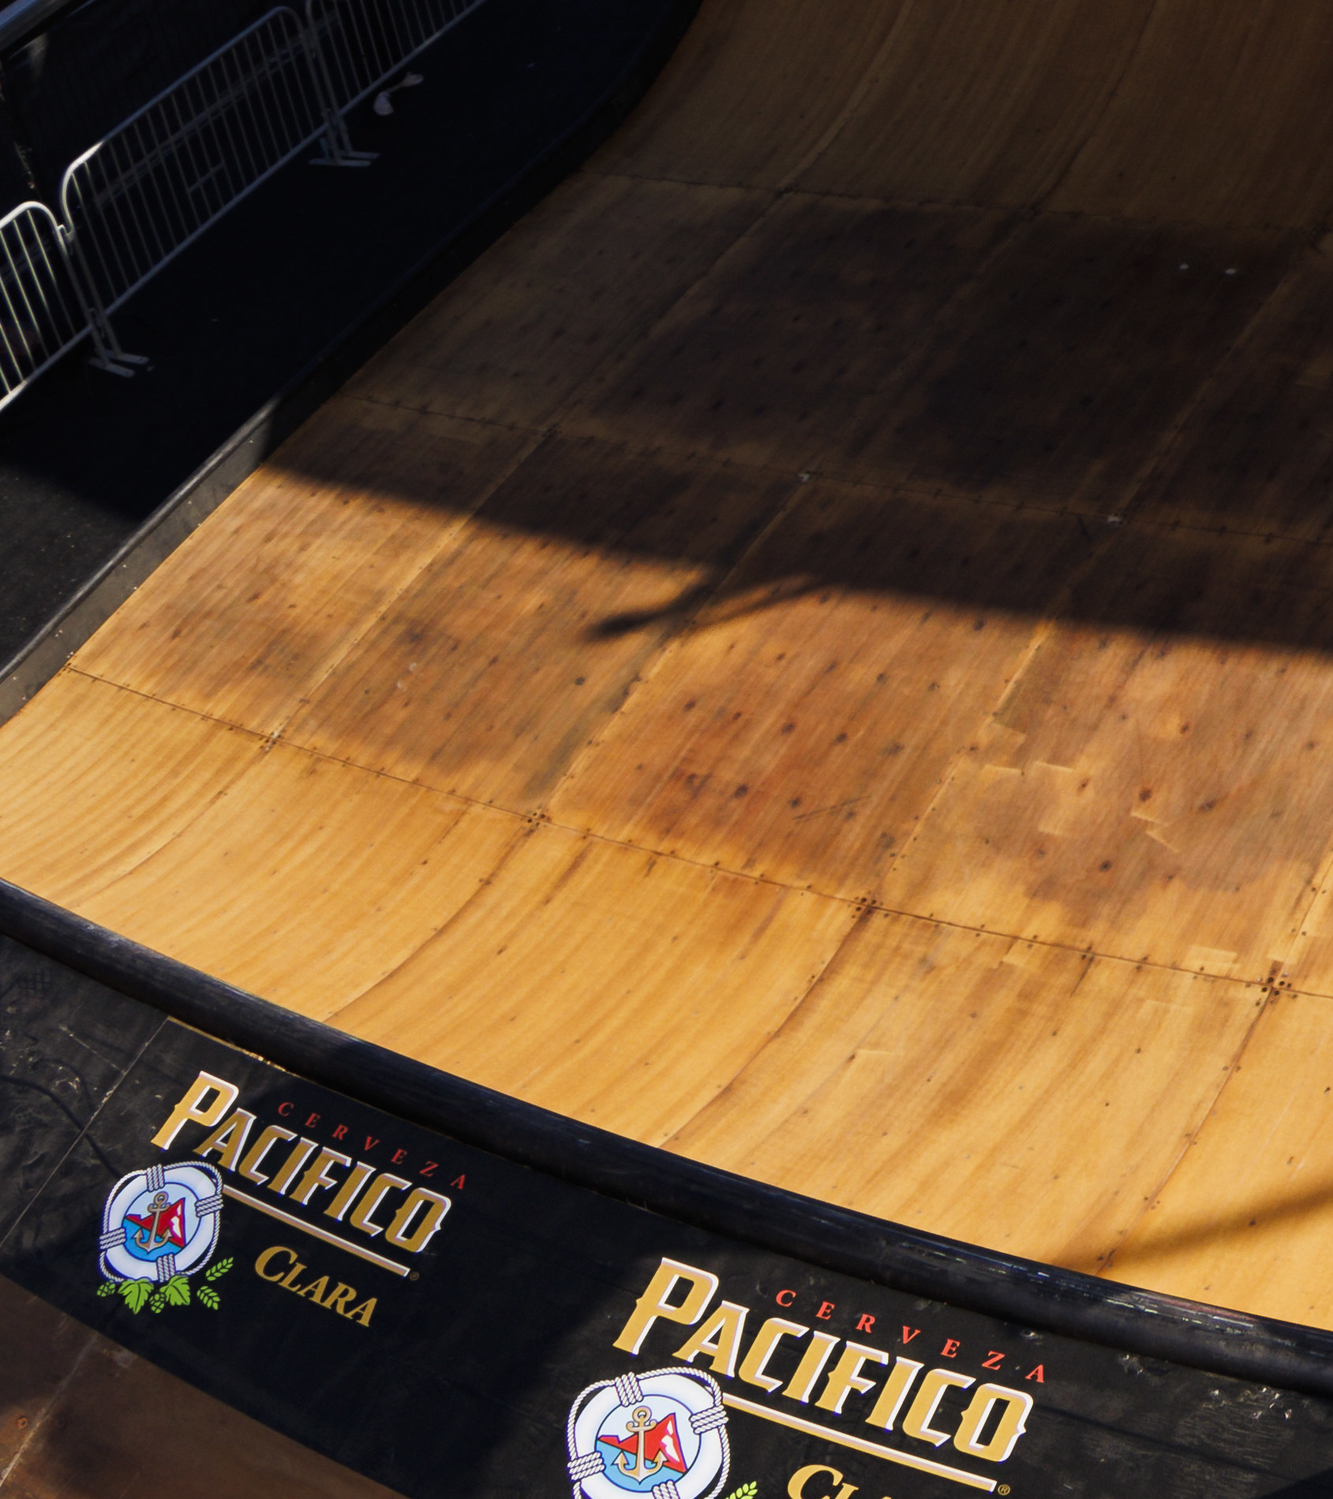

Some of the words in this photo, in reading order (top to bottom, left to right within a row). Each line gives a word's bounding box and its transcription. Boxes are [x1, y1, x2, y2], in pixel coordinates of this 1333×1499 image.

[150, 1070, 452, 1254] PACIFICO
[277, 1101, 467, 1190] CERVEZA
[254, 1245, 379, 1327] CLARA
[612, 1257, 1035, 1463] PACIFICO
[775, 1289, 1046, 1384] CERVEZA
